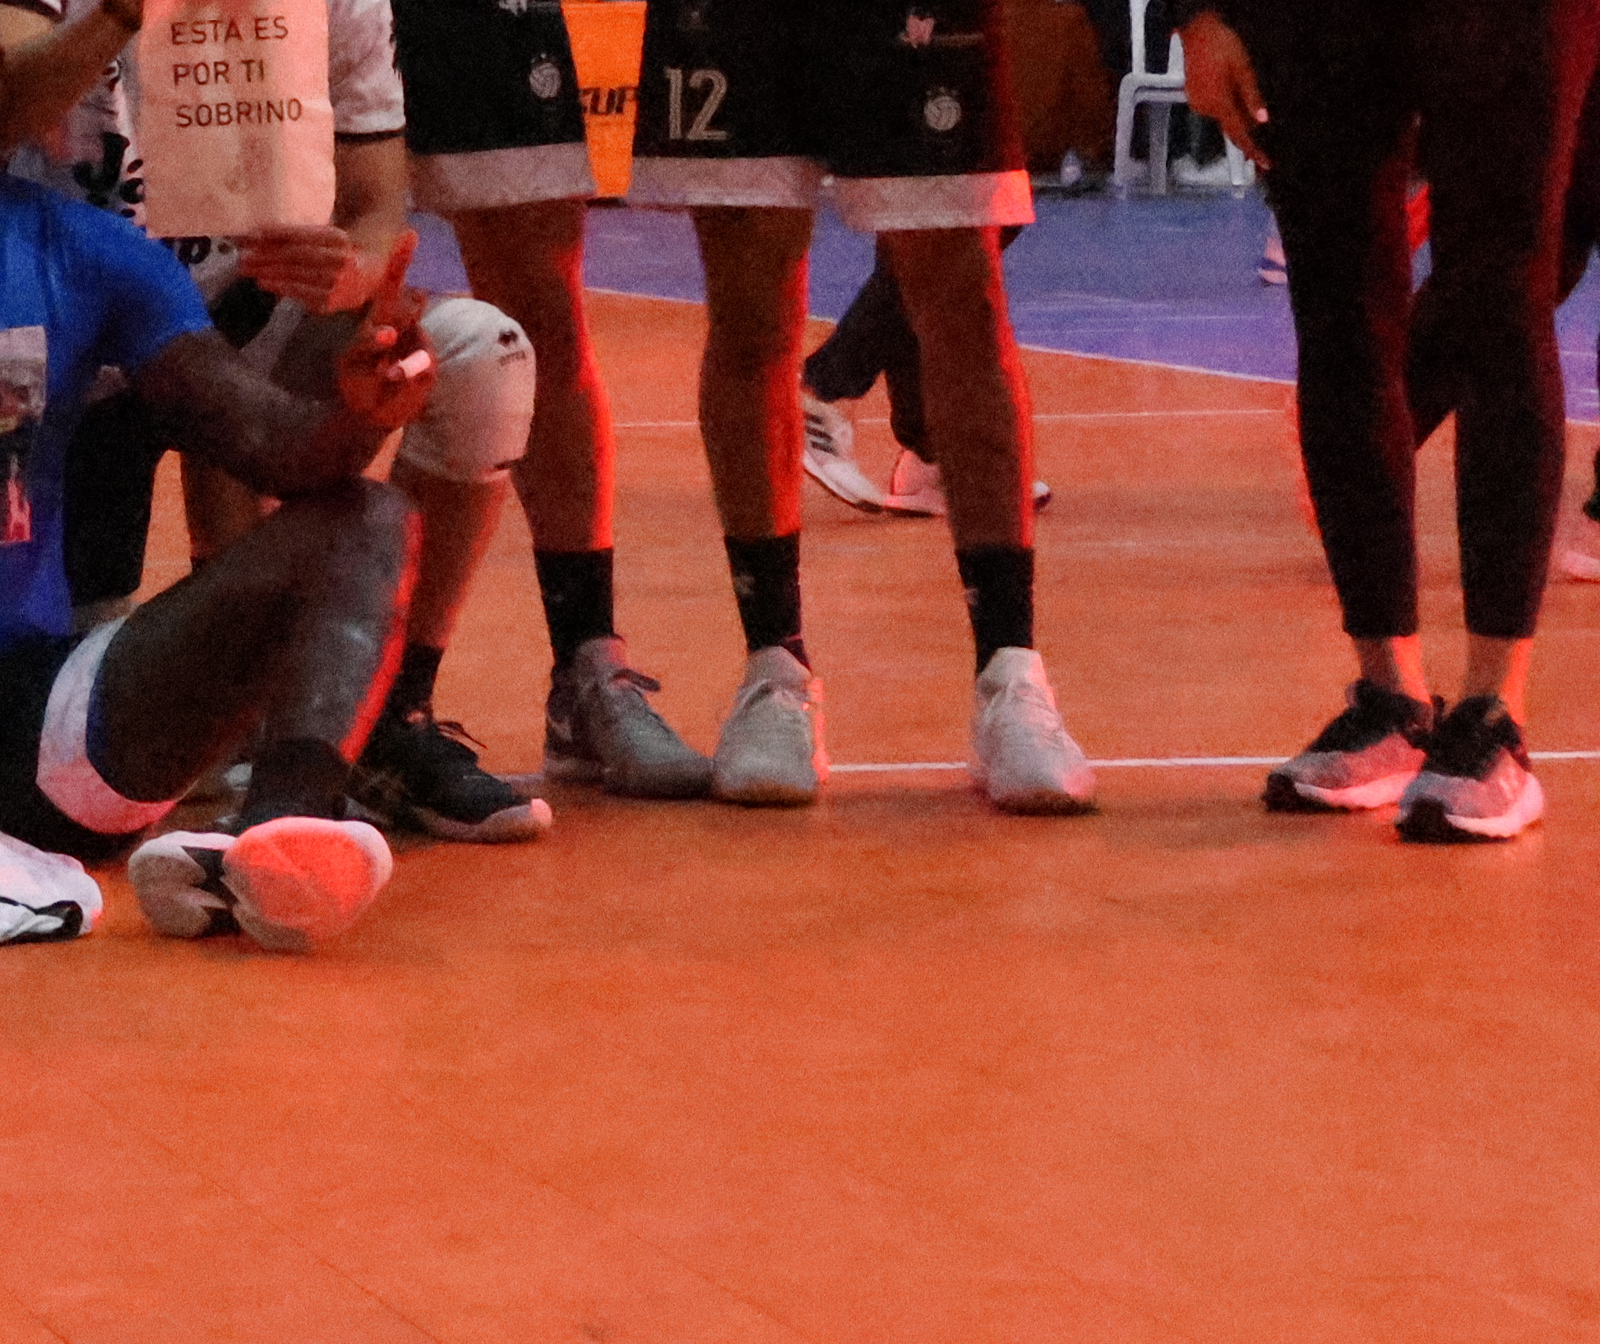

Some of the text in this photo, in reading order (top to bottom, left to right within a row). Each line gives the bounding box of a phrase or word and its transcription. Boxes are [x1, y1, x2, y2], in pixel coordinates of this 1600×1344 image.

[171, 16, 289, 46] ESTA ES
[173, 60, 265, 87] POR TI
[175, 98, 302, 129] SOBRINO
[664, 67, 730, 142] 12
